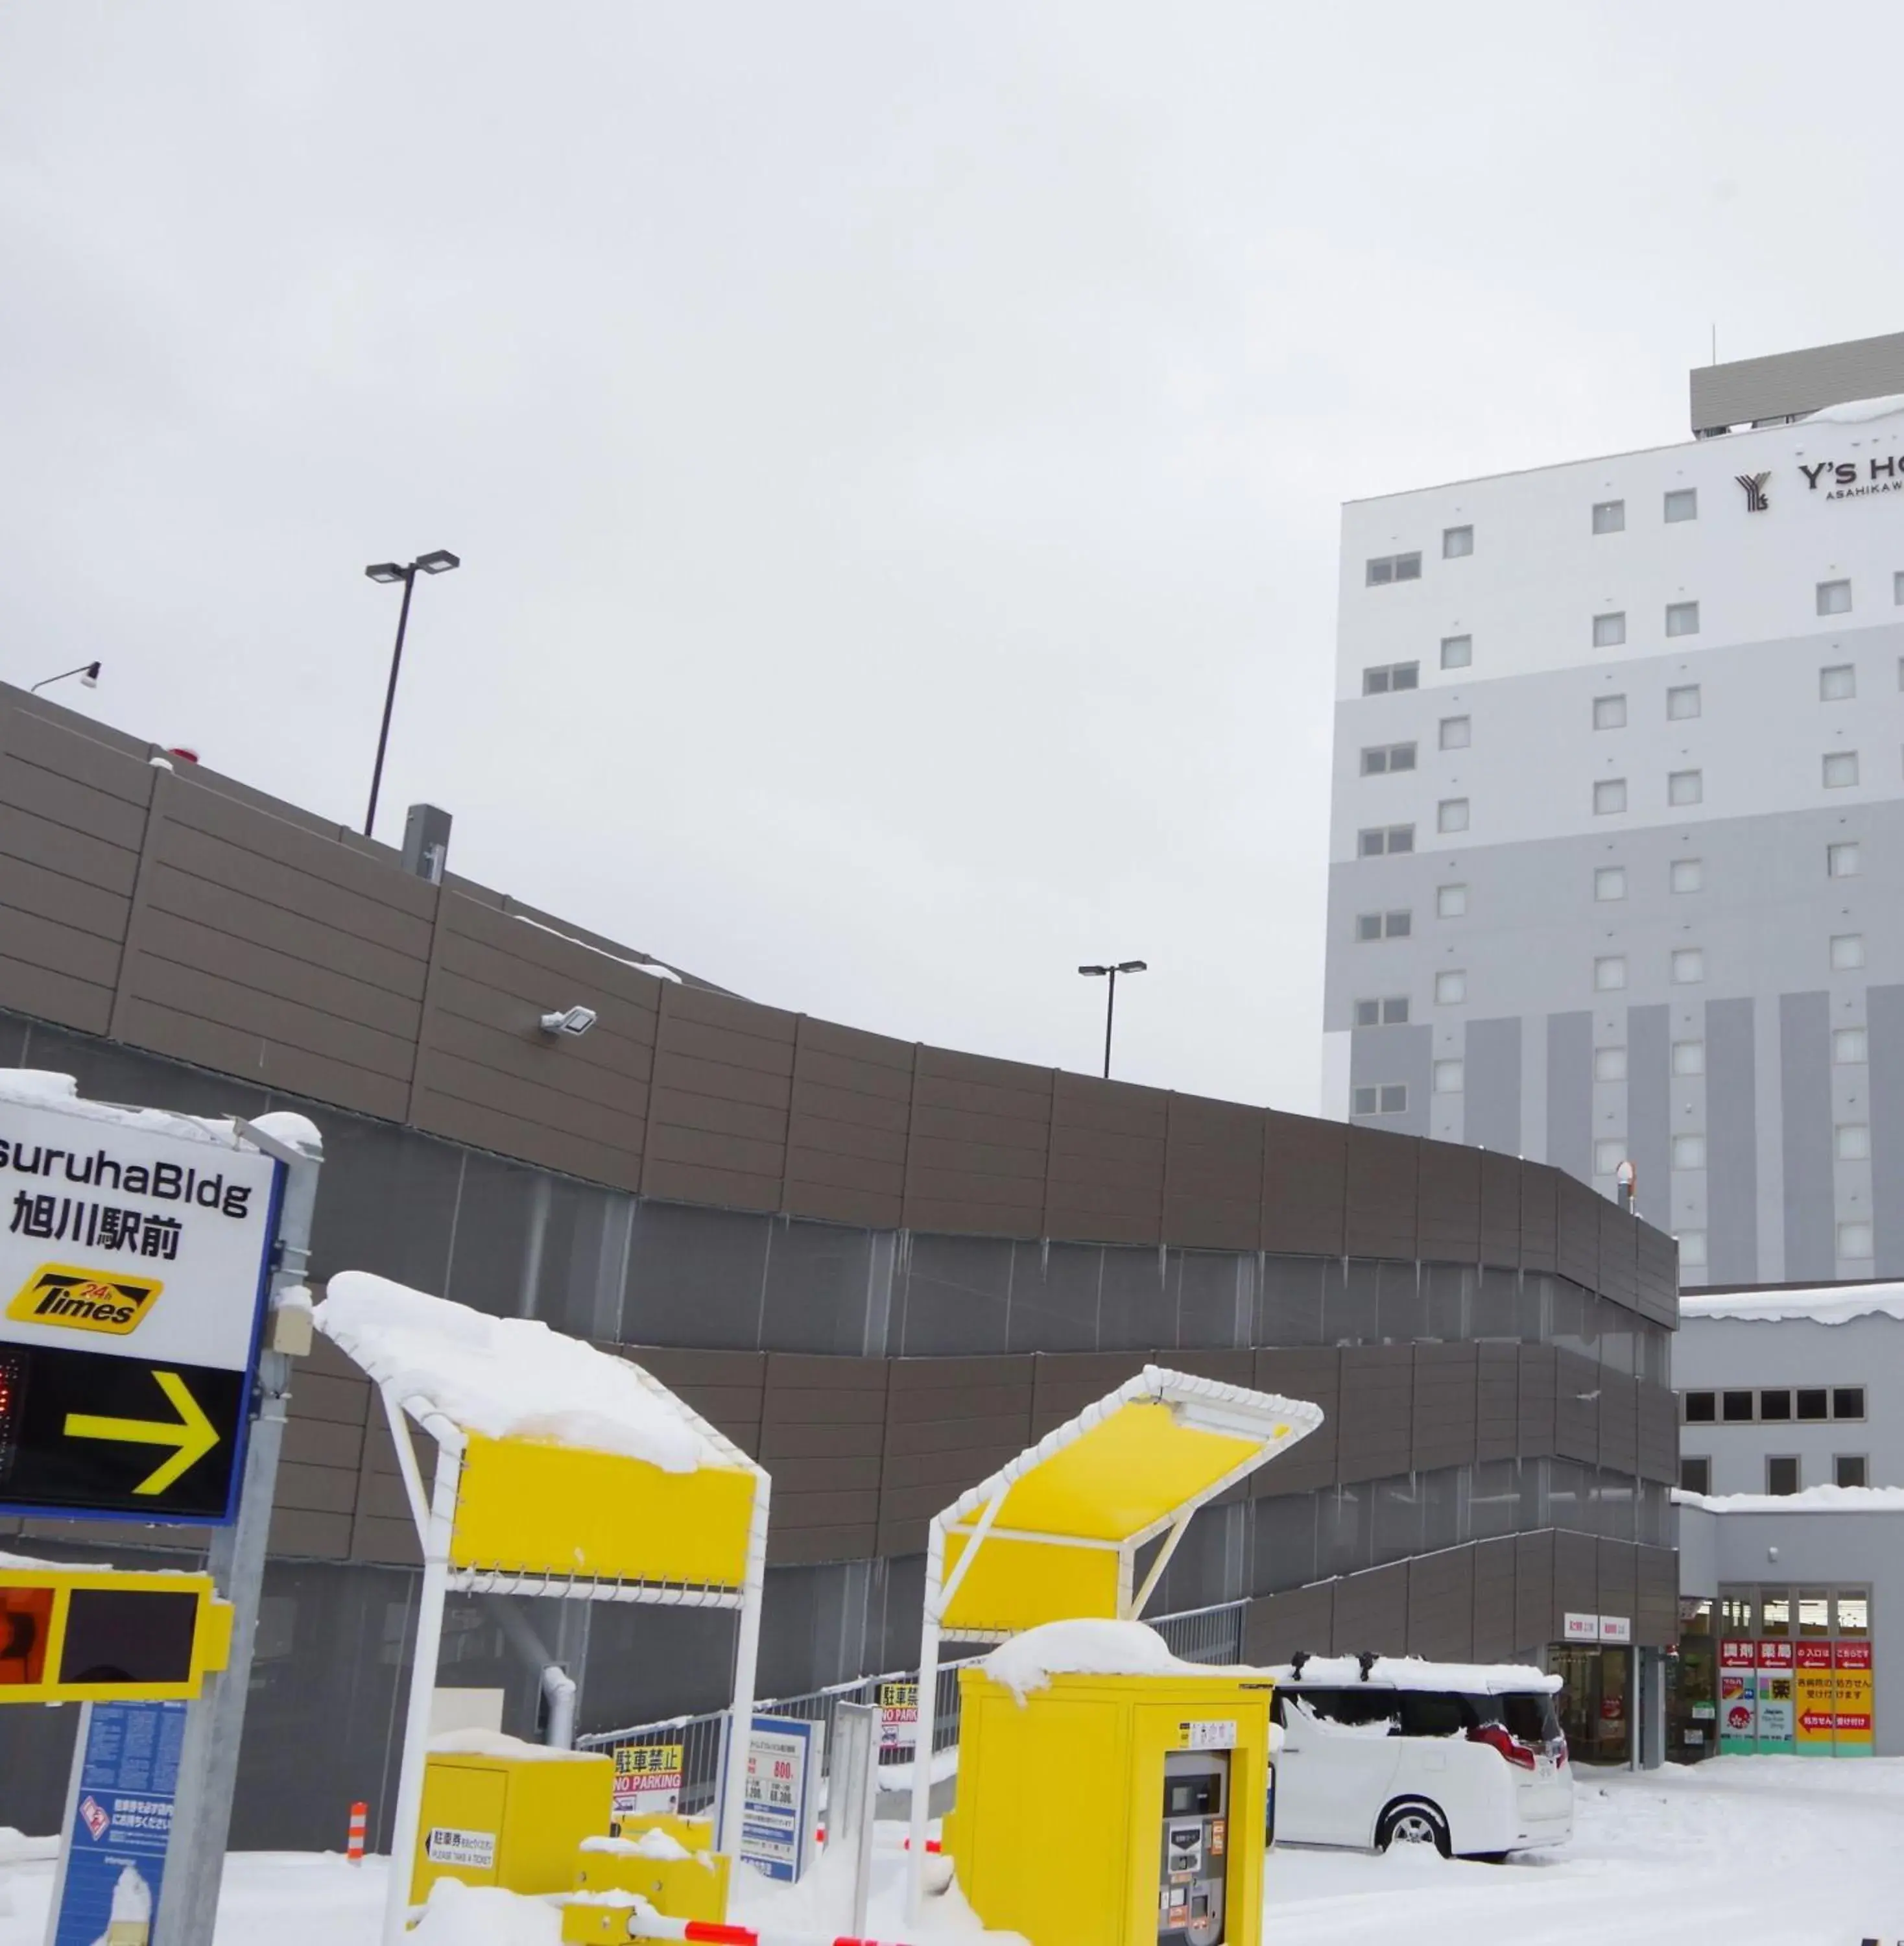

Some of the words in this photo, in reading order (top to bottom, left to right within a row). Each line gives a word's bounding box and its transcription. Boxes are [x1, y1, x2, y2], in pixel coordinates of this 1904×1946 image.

[1870, 455, 1904, 480] H
[10, 1190, 182, 1261] 旭川駅前
[34, 1284, 136, 1324] Times
[883, 1686, 919, 1705] 駐車禁
[615, 1748, 678, 1773] 駐車禁止
[613, 1775, 630, 1791] NO
[632, 1774, 682, 1790] PARKING
